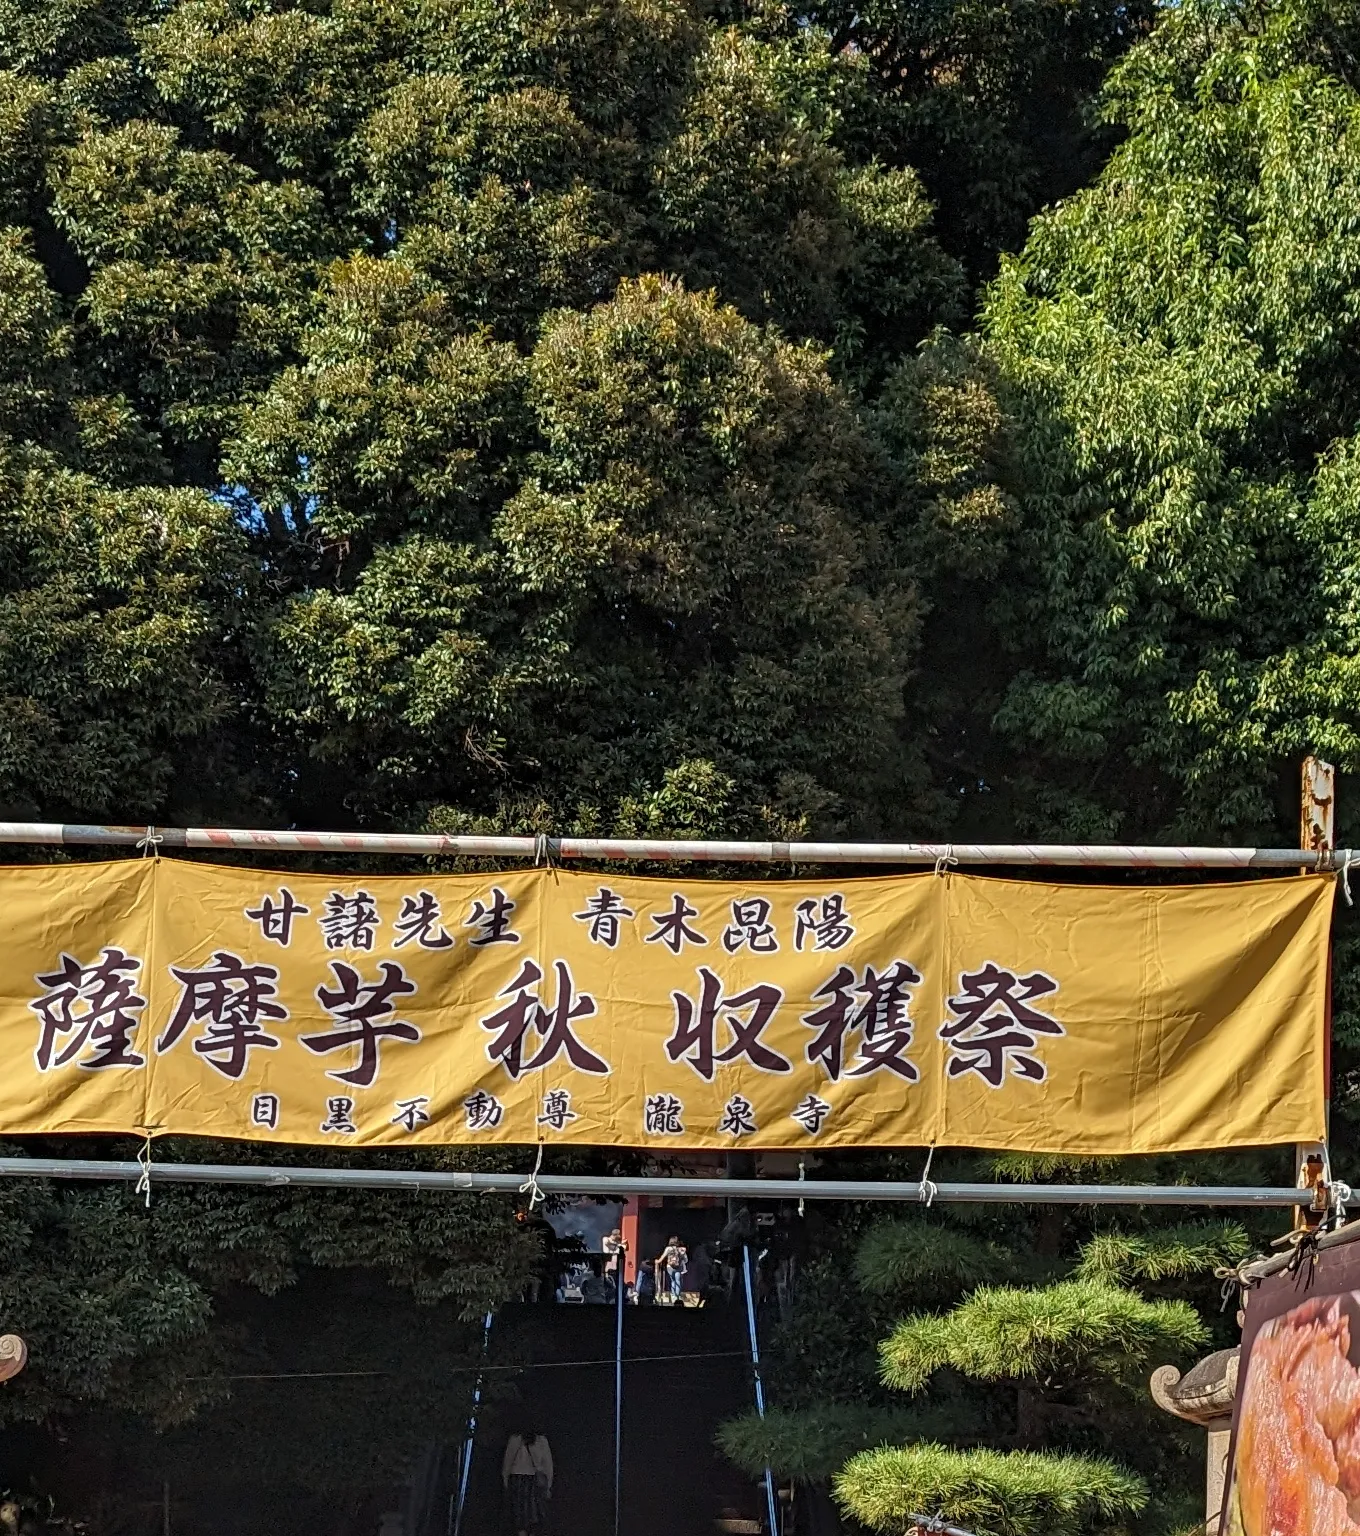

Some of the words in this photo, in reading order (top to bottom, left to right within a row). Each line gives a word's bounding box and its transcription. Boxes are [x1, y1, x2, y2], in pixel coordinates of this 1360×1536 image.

[575, 887, 856, 954] 青木昆陽
[29, 947, 422, 1087] 薩摩芋
[480, 958, 612, 1081] 秋
[664, 958, 1066, 1089] 収穫祭
[250, 1090, 575, 1134] 目黒不動尊
[644, 1093, 834, 1136] 瀧泉寺
